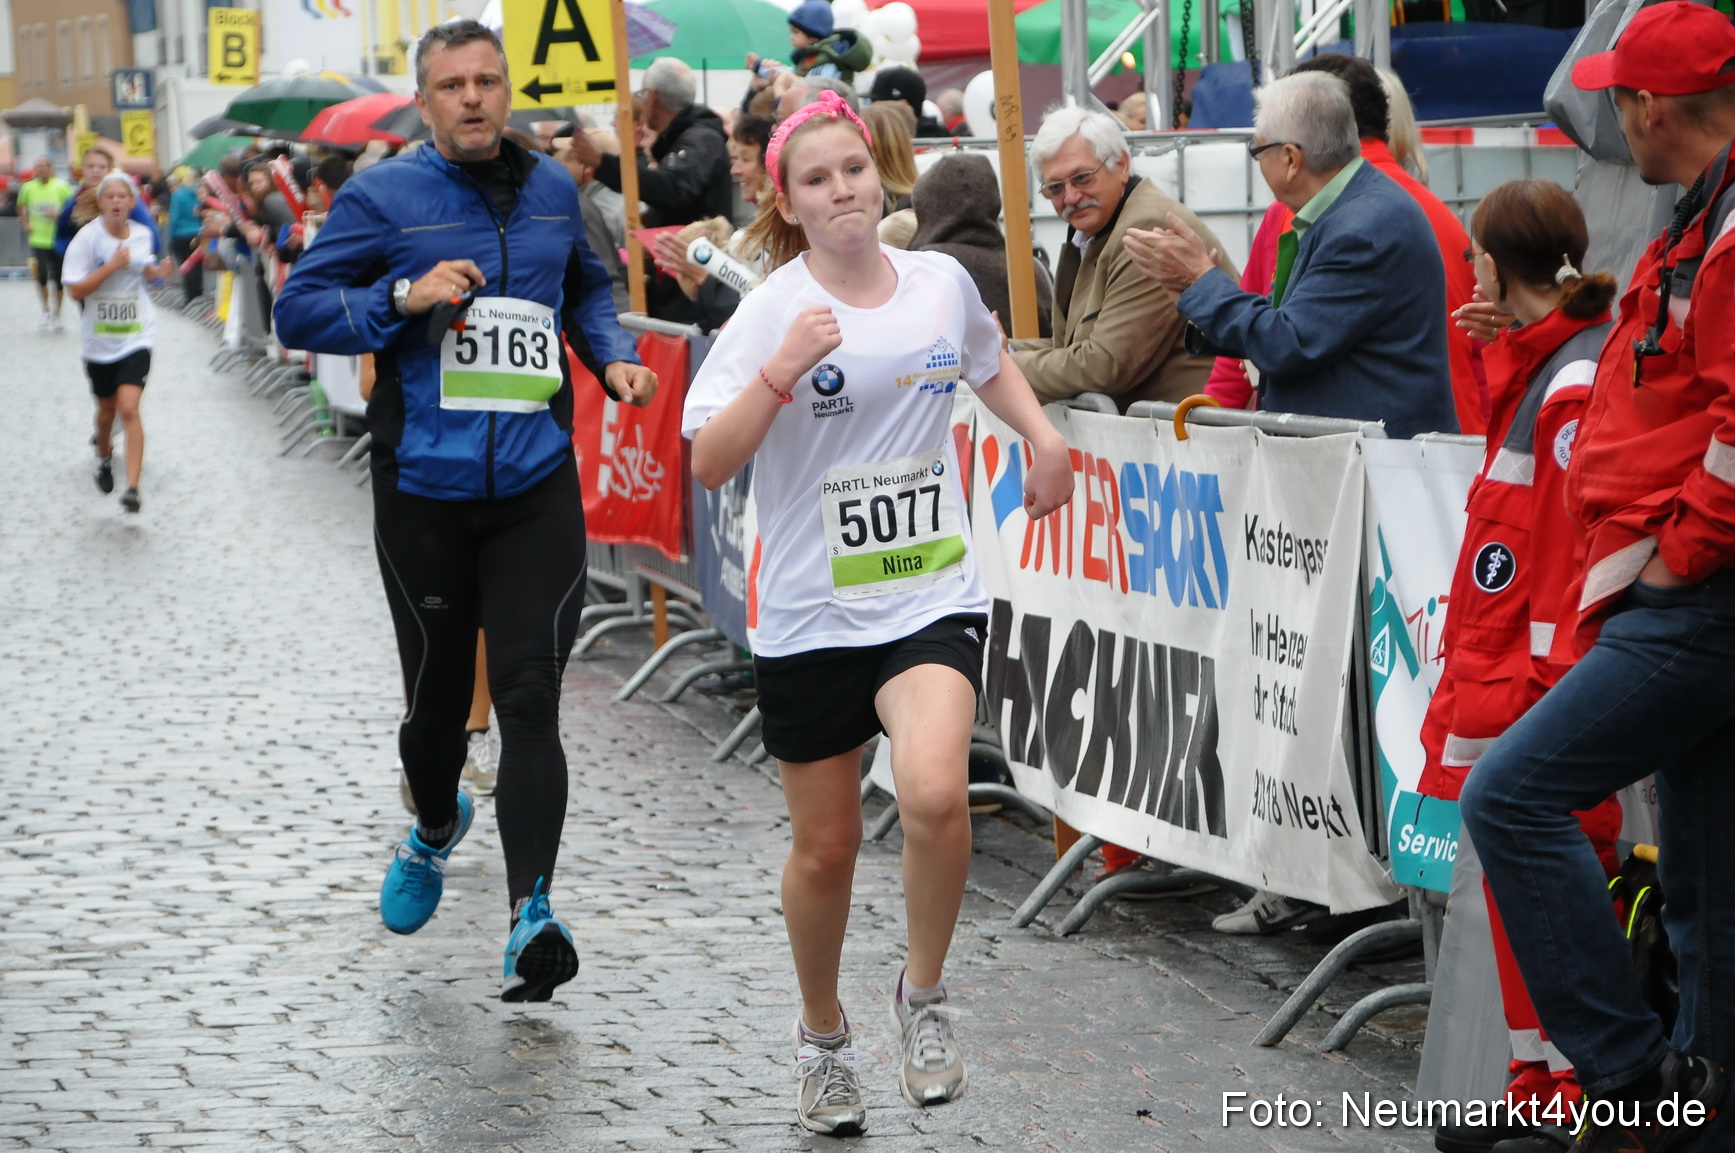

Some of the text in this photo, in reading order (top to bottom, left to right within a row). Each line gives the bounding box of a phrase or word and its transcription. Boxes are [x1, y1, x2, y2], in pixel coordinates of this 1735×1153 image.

[214, 11, 254, 25] Block
[531, 0, 601, 65] A
[222, 31, 246, 68] B
[97, 302, 136, 320] 5080
[455, 325, 548, 370] 5163
[812, 396, 853, 412] PARTL
[814, 405, 854, 419] Neumarkt
[823, 467, 929, 495] PARTL Neumarkt
[838, 483, 941, 548] 5077
[832, 546, 840, 556] S
[882, 554, 923, 576] Nina
